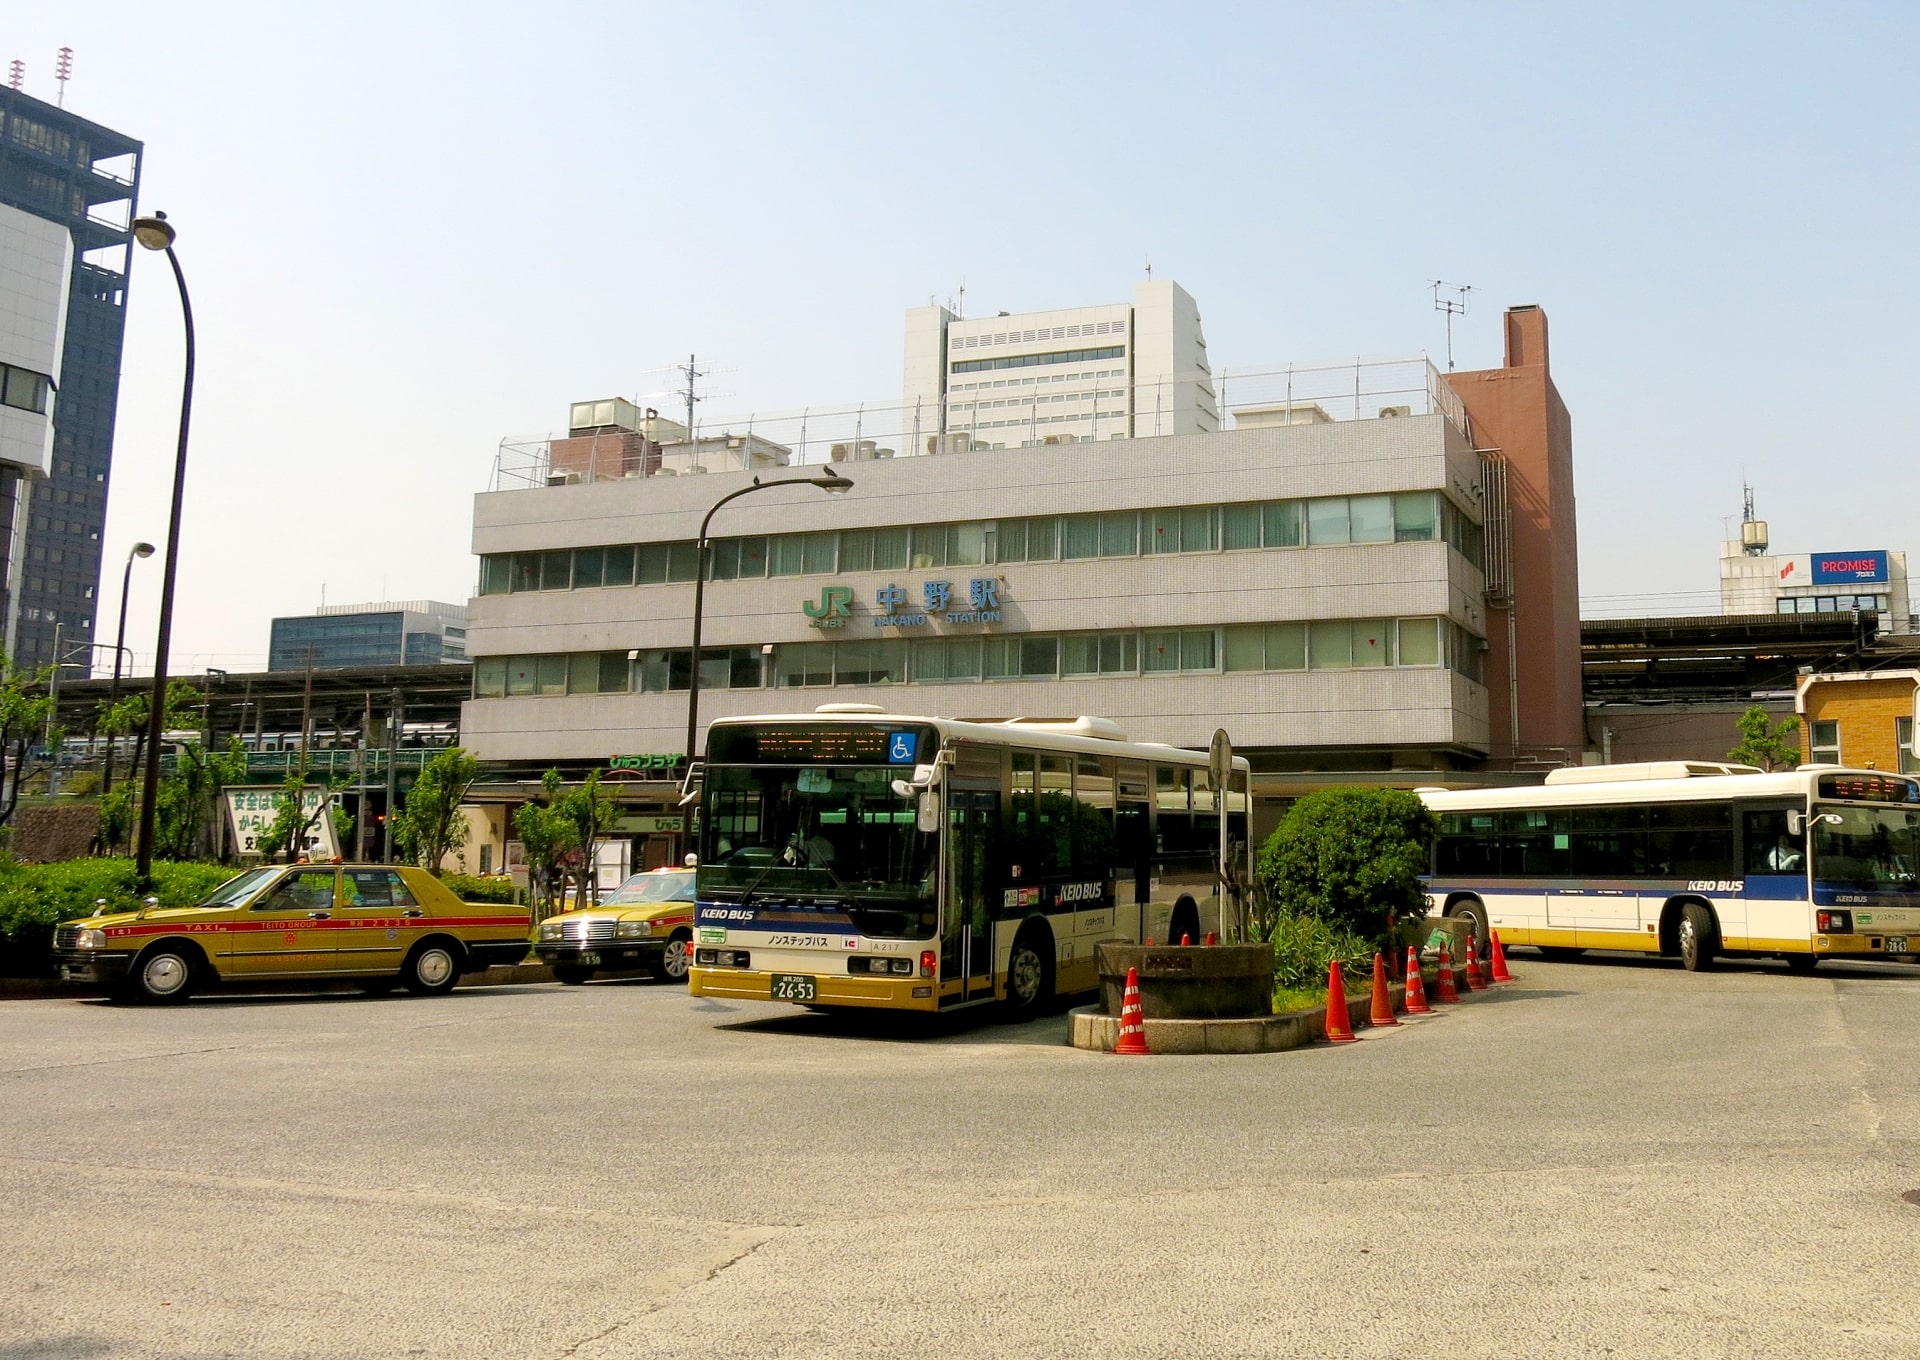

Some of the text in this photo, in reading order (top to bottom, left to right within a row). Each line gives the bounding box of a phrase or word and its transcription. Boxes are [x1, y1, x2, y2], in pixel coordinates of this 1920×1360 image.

[1821, 559, 1876, 572] PROMISE
[803, 586, 855, 618] JR
[876, 578, 999, 614] 中野駅
[873, 611, 1000, 627] NAKANO STATION
[1060, 882, 1102, 901] KEIO BUS
[1687, 880, 1744, 892] KEIO BUS
[1835, 895, 1868, 903] KEIO BUS
[700, 908, 755, 920] KEIO BUS
[287, 921, 318, 929] GROUP
[768, 935, 828, 947] ノンステップバス
[844, 940, 856, 948] IC
[778, 982, 814, 999] 26-53
